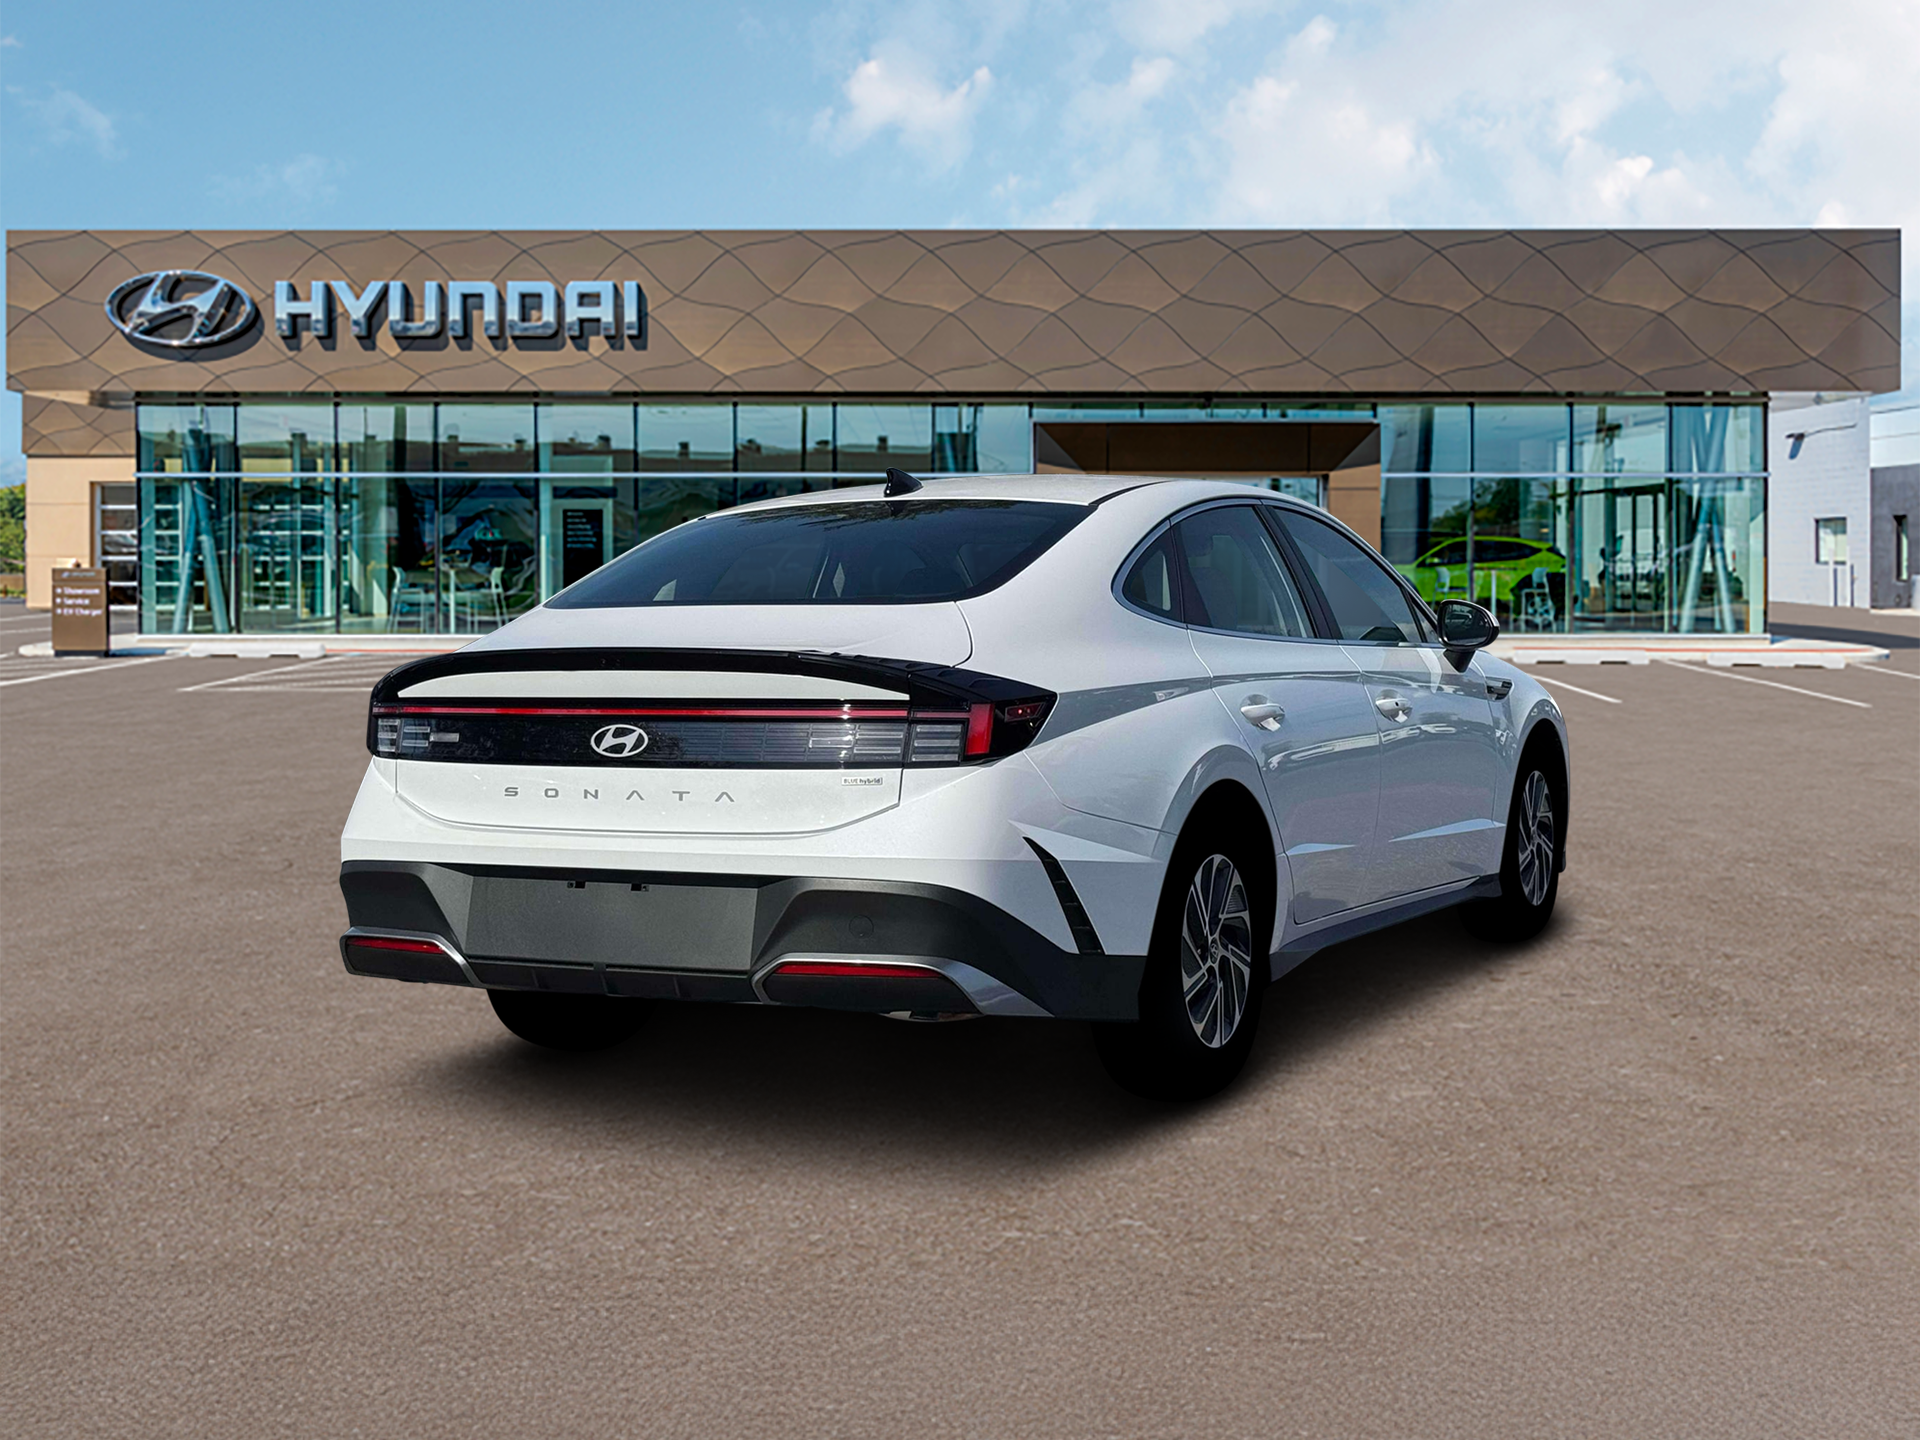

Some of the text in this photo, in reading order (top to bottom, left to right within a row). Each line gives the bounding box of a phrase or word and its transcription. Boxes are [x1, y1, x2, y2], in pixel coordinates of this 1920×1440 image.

[273, 279, 641, 340] HYUNDAI
[63, 597, 90, 605] Service
[859, 777, 881, 785] hybrid
[504, 786, 735, 803] SONATA
